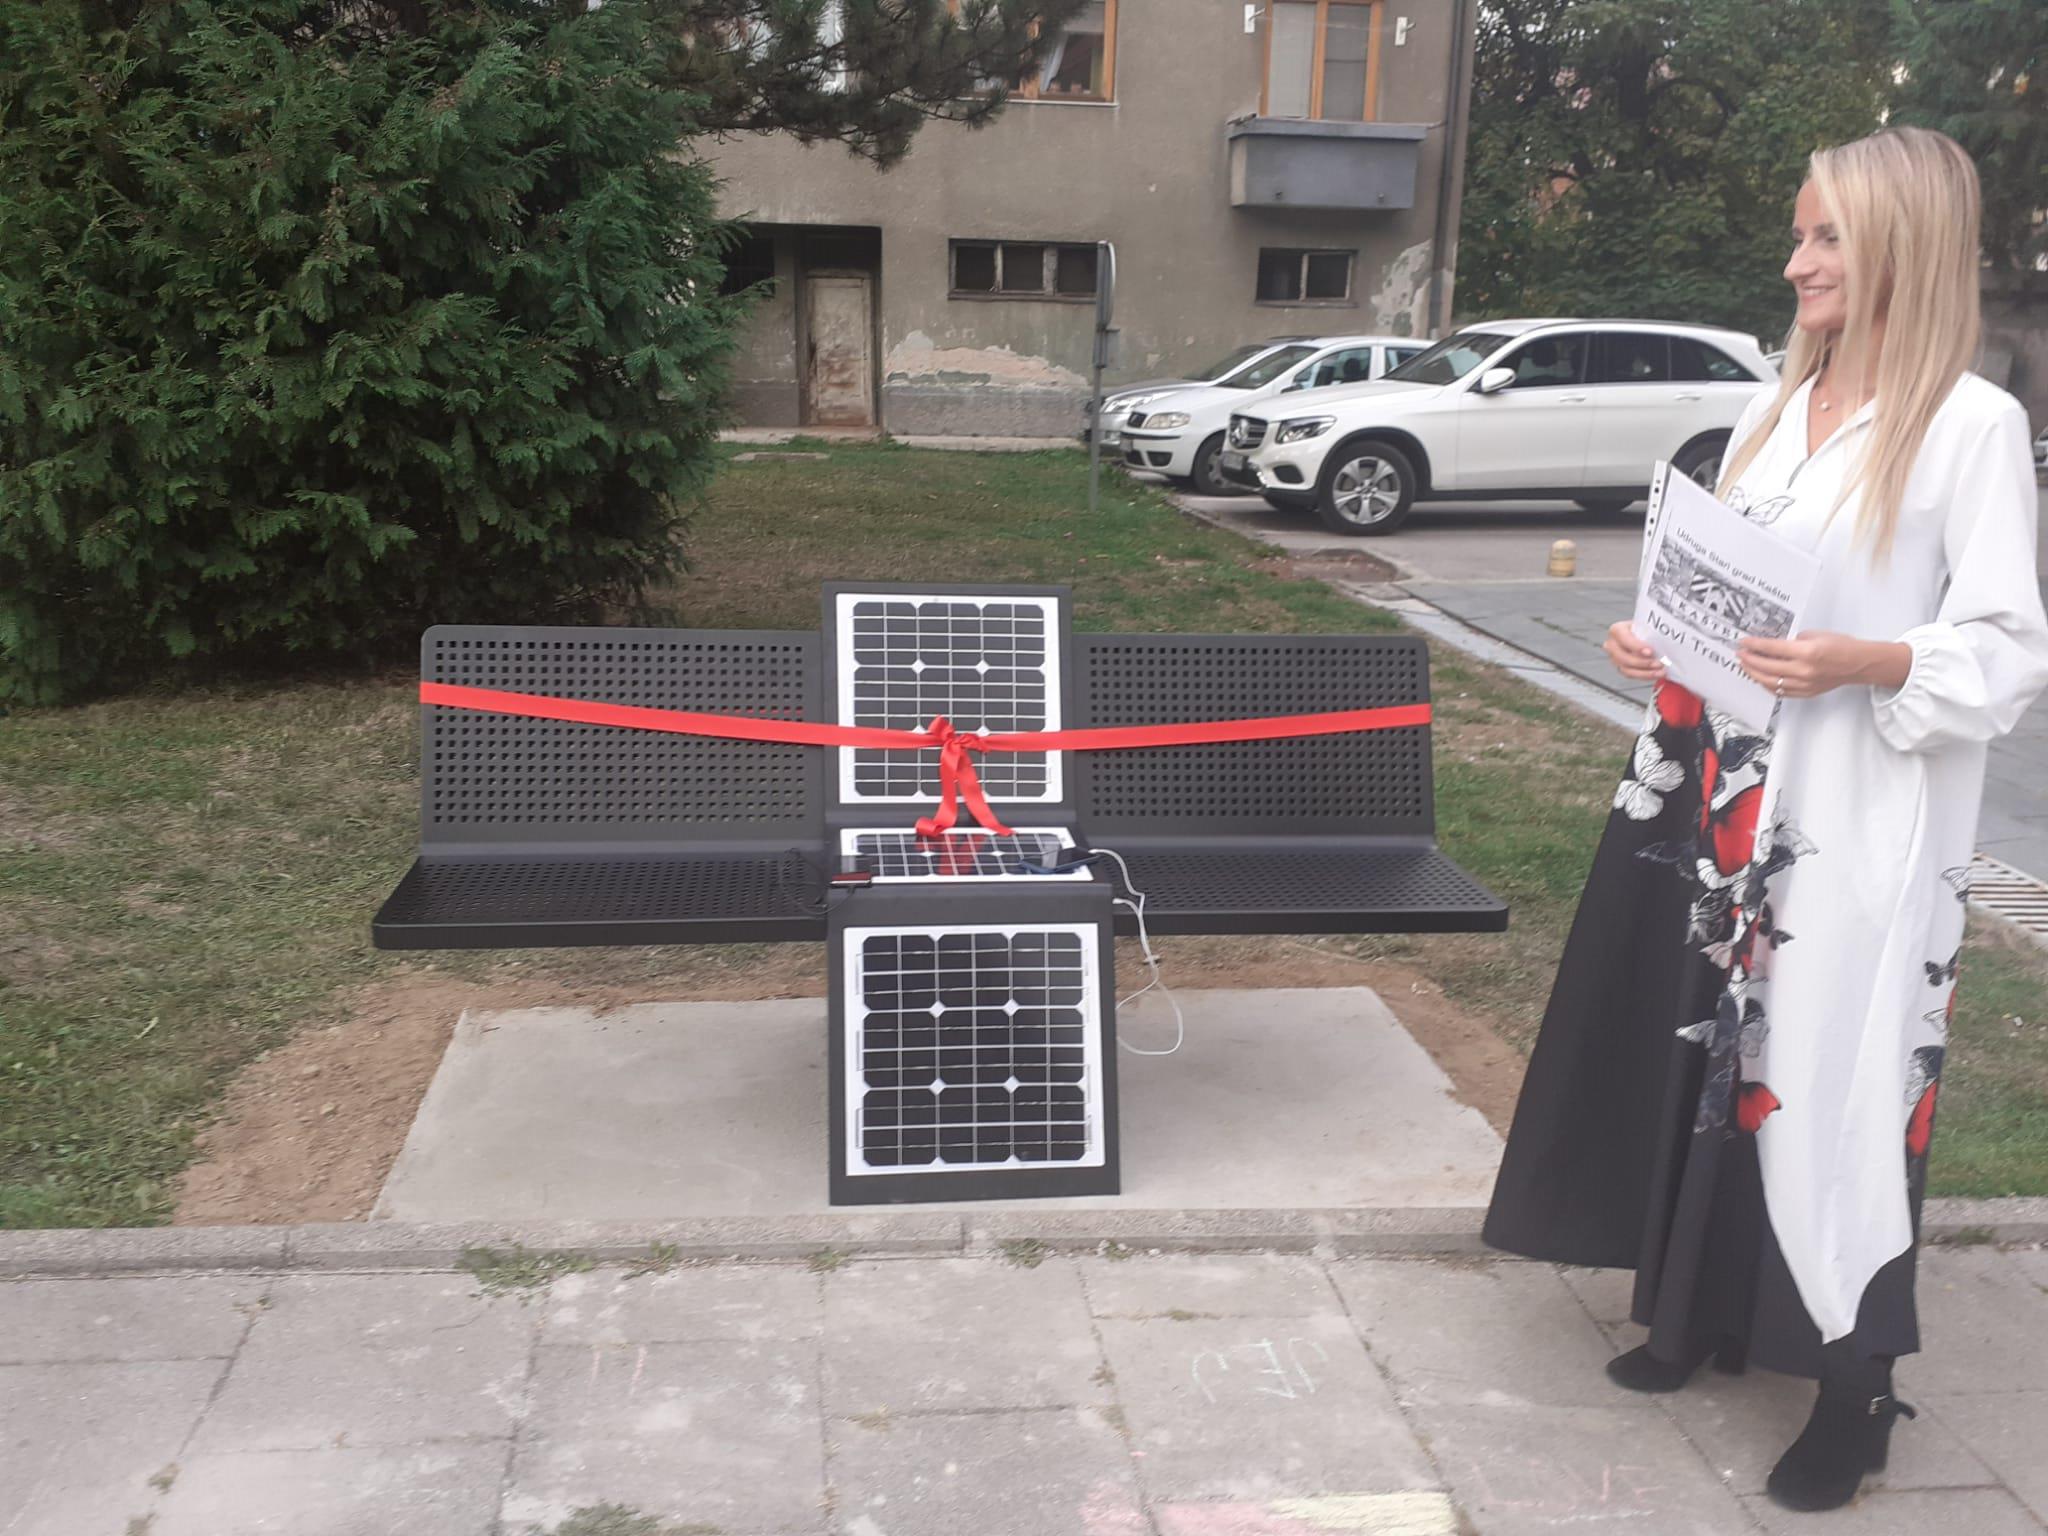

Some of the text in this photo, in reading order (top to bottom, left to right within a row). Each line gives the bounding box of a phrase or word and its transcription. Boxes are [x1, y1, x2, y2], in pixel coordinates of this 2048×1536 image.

[1676, 527, 1707, 555] Udruga
[1708, 551, 1732, 571] Stari
[1732, 566, 1757, 586] grad
[1647, 610, 1686, 645] Novi
